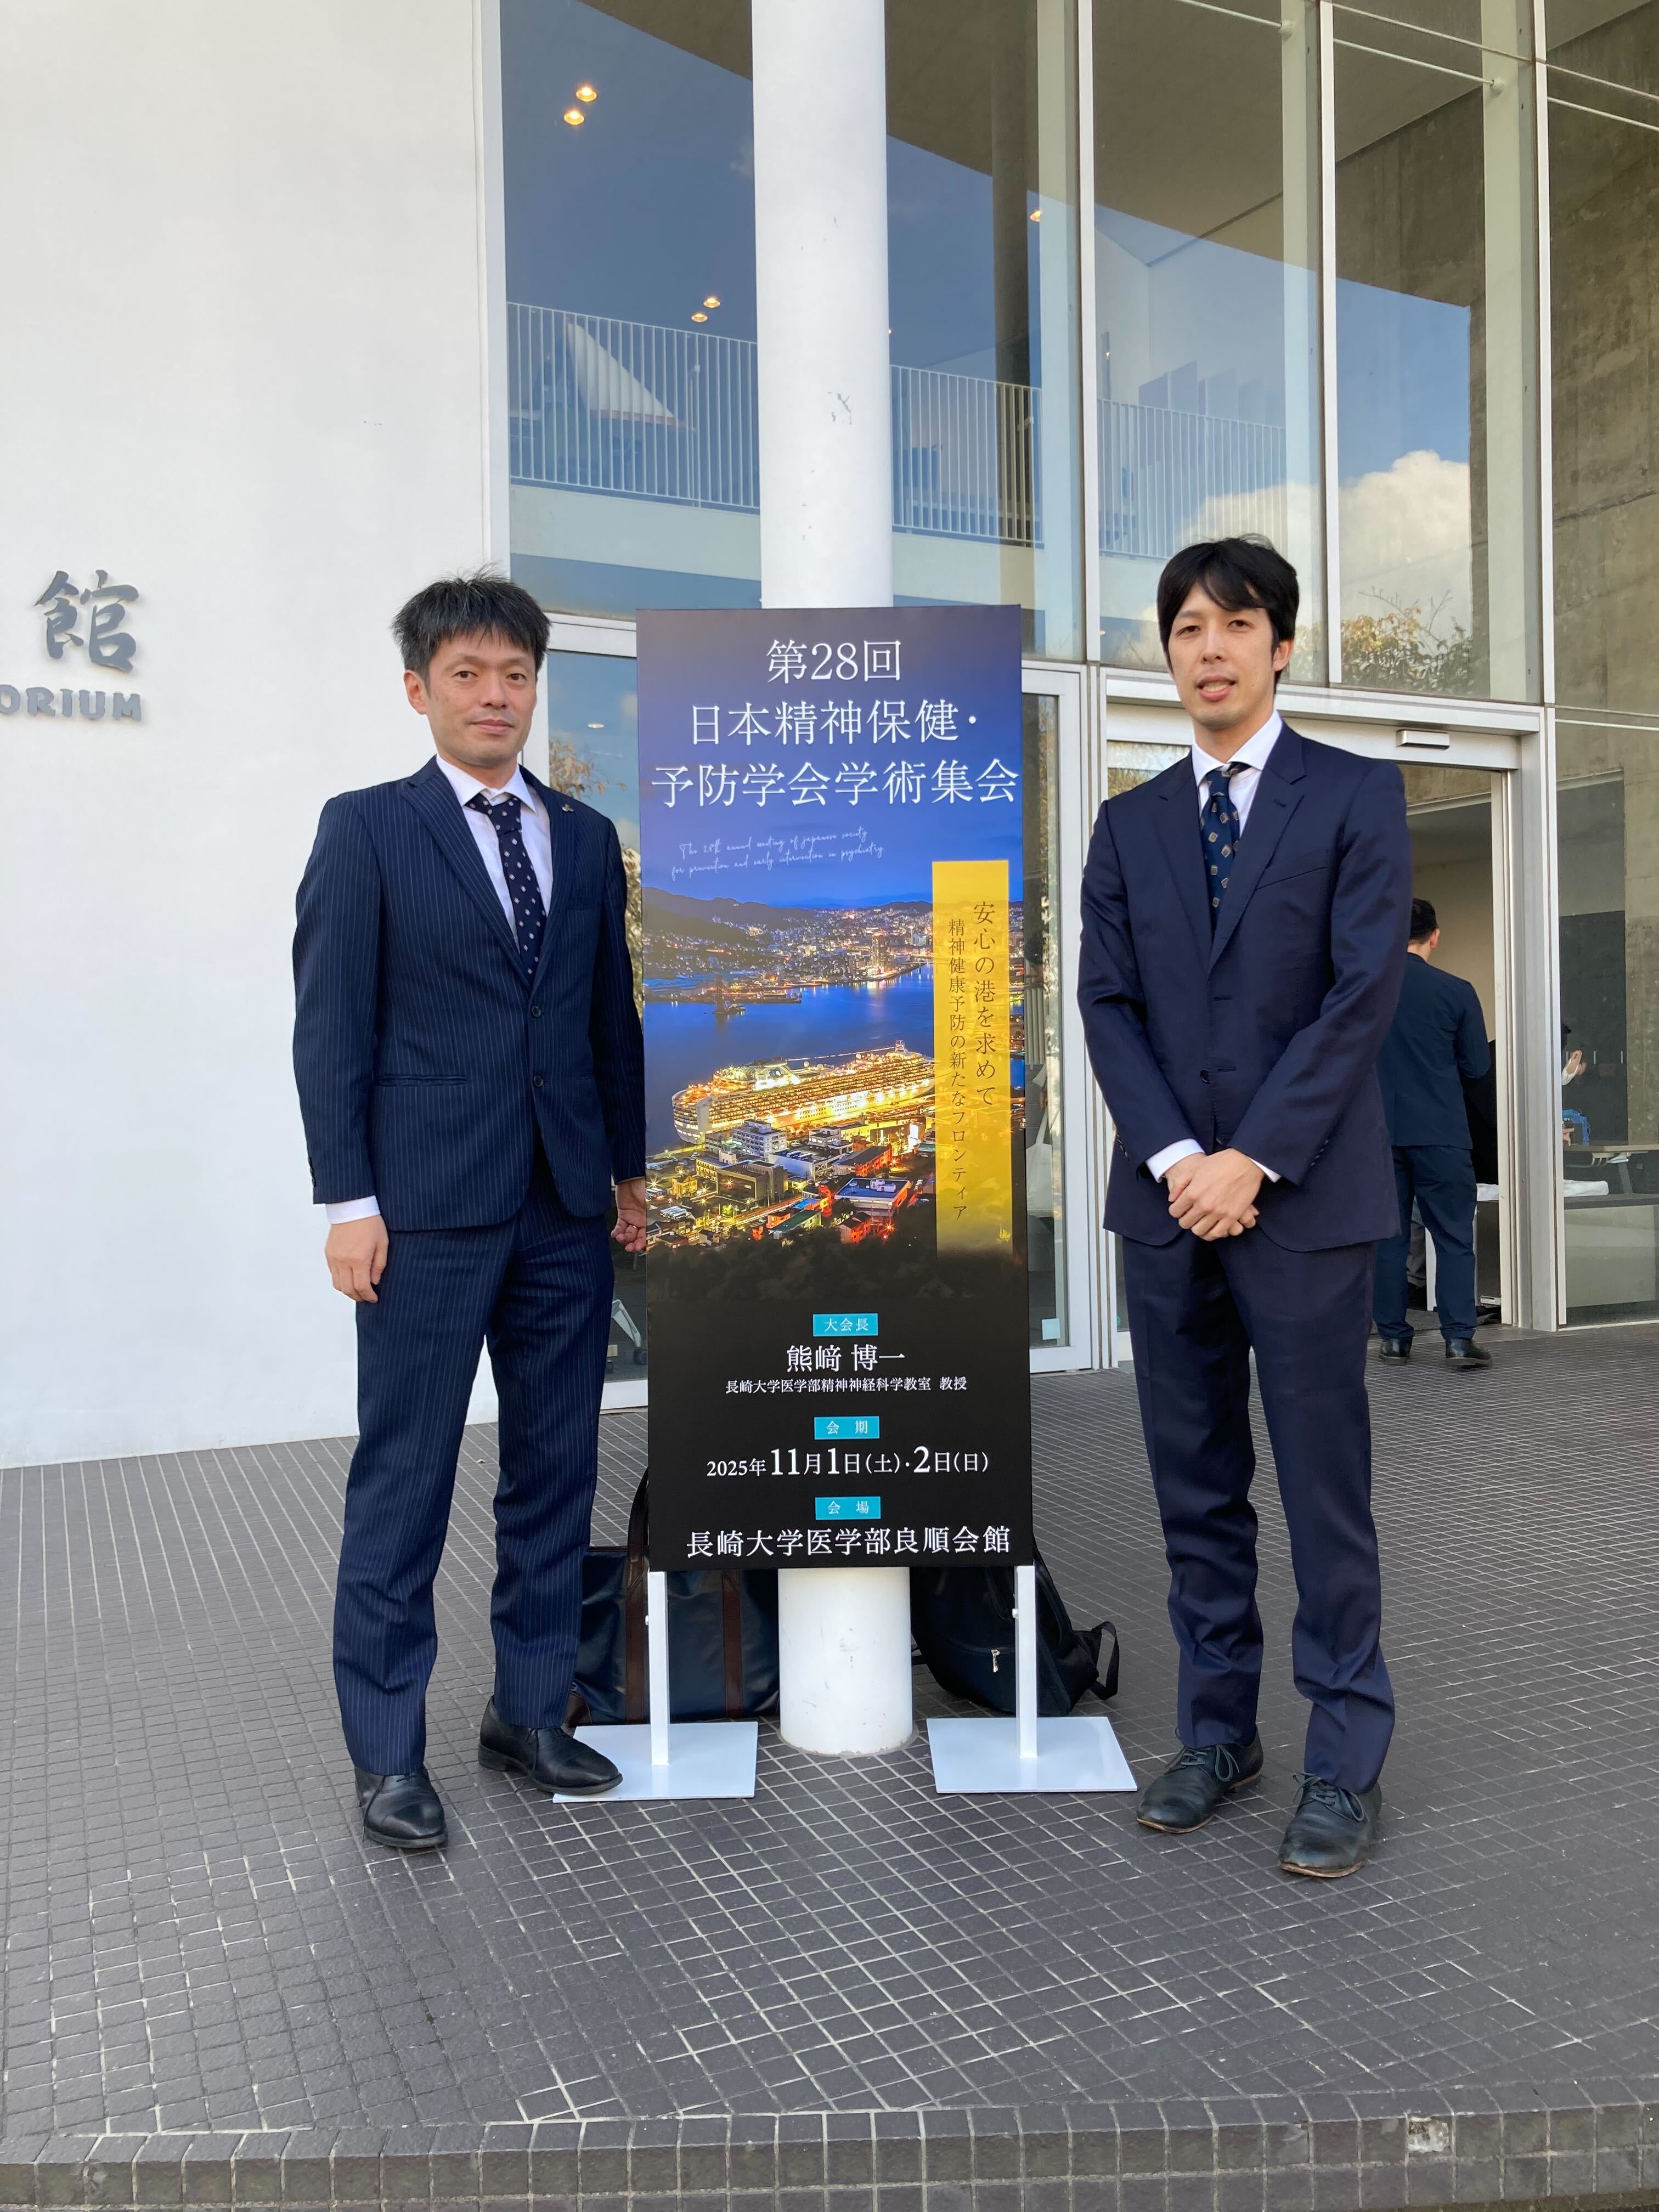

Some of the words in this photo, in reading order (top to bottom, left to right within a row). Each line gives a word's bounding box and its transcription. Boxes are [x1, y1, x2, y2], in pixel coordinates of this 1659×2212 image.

[766, 639, 901, 684] 第28回
[651, 758, 1019, 809] 予防学会学術集会
[679, 842, 698, 860] The
[703, 838, 721, 855] 28th
[726, 836, 752, 851] annual
[790, 836, 799, 850] of
[672, 866, 685, 881] for
[734, 854, 749, 868] and
[753, 851, 774, 870] early
[973, 901, 996, 1105] 安心の港を求めて
[949, 918, 967, 1220] 精神健康予防の新たなフロンティア
[824, 1317, 869, 1332] 大会長
[850, 1344, 905, 1372] 博一
[725, 1377, 931, 1394] 長崎大学医学部精神神経科学教室
[939, 1376, 967, 1391] 教授
[686, 1525, 1011, 1559] 長崎大学医学部良順会館
